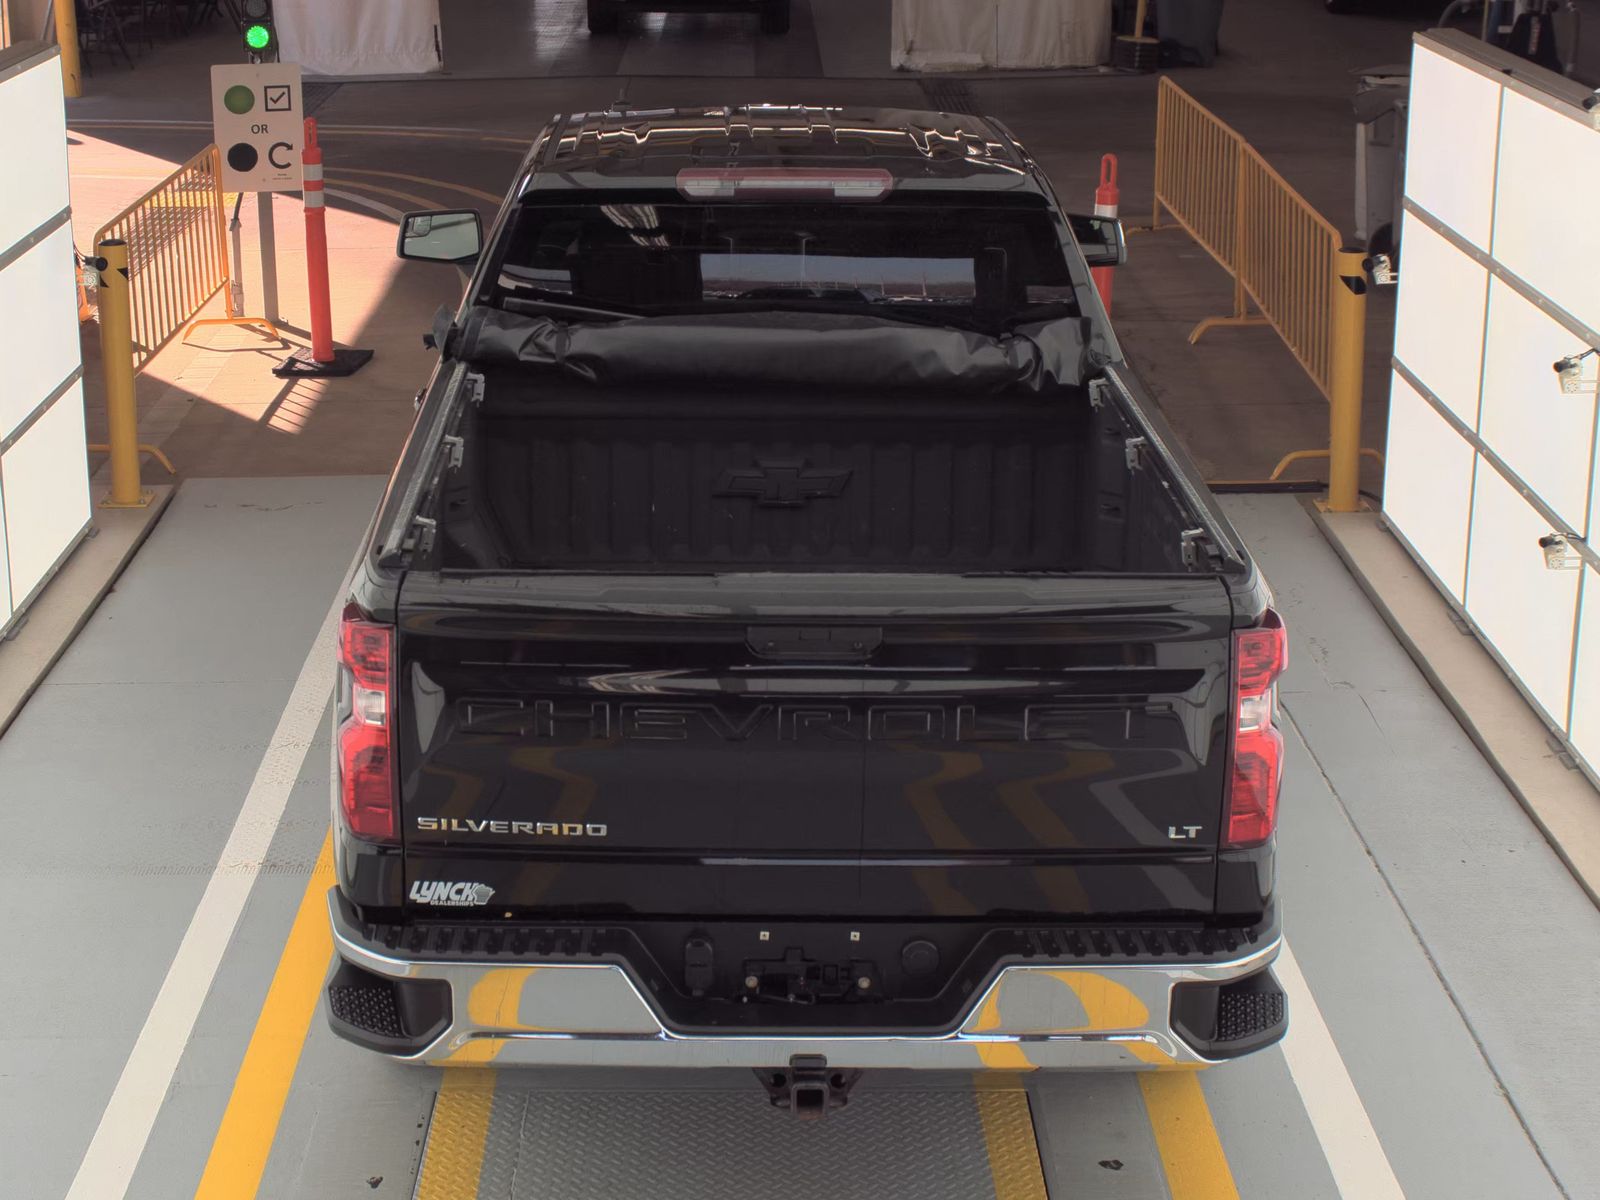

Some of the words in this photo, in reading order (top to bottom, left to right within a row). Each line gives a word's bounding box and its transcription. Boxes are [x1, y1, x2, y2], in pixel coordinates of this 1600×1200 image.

[251, 124, 269, 135] OR
[456, 700, 1174, 741] CHEVROLET
[417, 816, 608, 837] SILVERADO
[1168, 826, 1203, 839] LT
